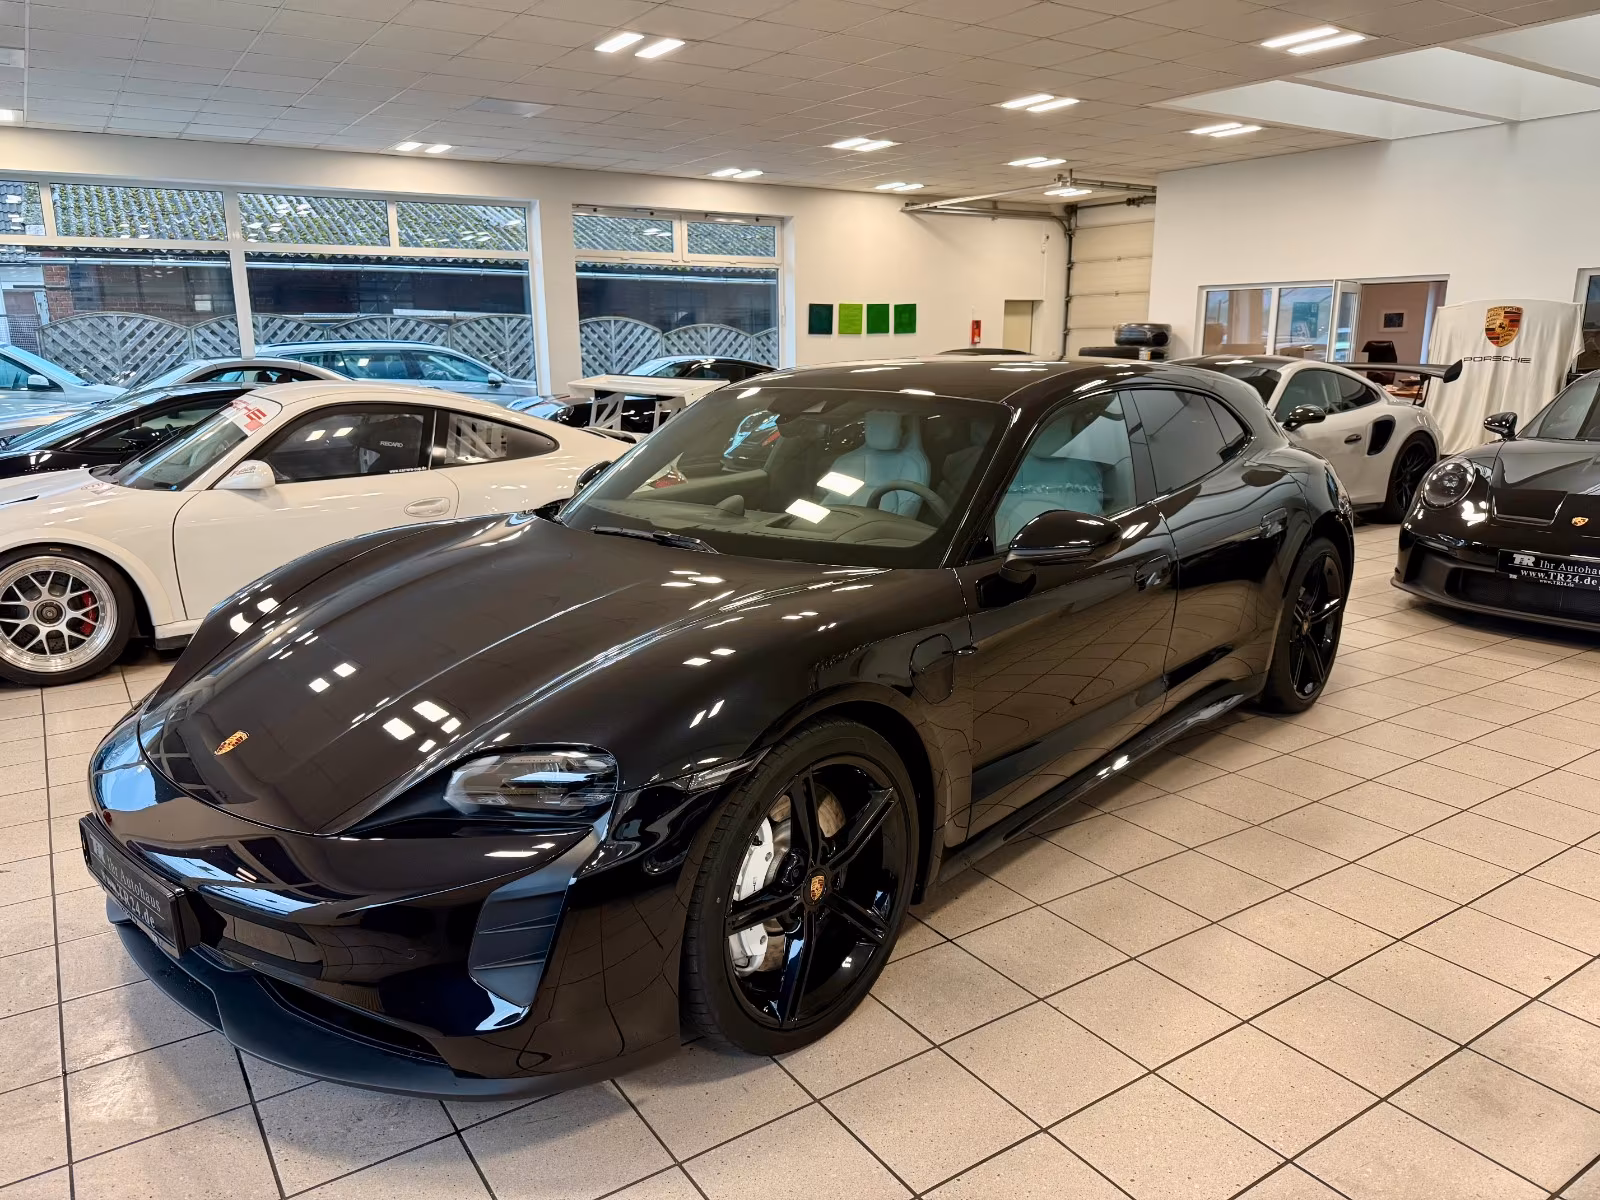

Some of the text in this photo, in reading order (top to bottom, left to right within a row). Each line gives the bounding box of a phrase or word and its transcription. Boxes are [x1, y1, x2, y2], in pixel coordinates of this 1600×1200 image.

[1463, 355, 1532, 364] PORSCHE
[1540, 560, 1600, 576] Ihr Autoha
[1520, 569, 1598, 586] www.TR24.de
[121, 868, 161, 913] Autohaus
